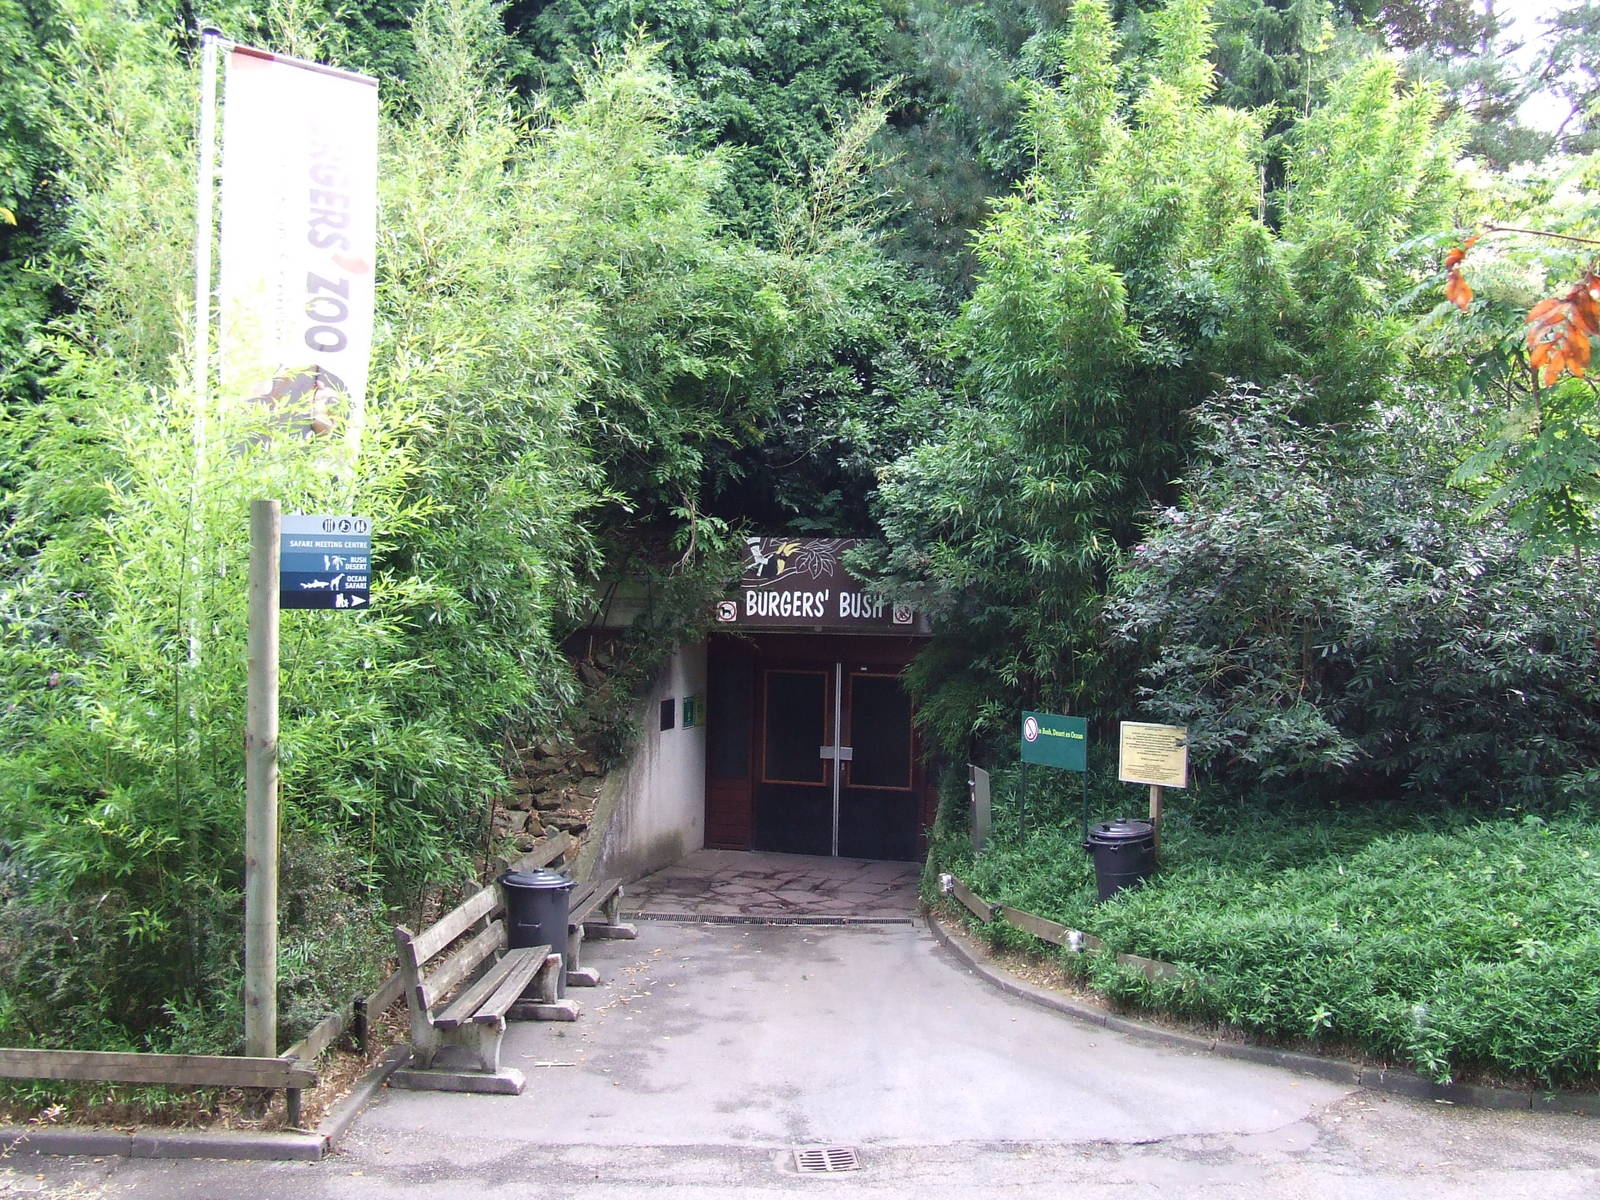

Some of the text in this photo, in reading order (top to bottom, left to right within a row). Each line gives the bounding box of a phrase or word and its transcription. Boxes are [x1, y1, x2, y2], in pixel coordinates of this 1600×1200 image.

[305, 271, 350, 353] ZOO
[315, 540, 343, 548] MEETING
[344, 541, 368, 549] CENTRE
[746, 589, 883, 619] BURGERS' BUSH
